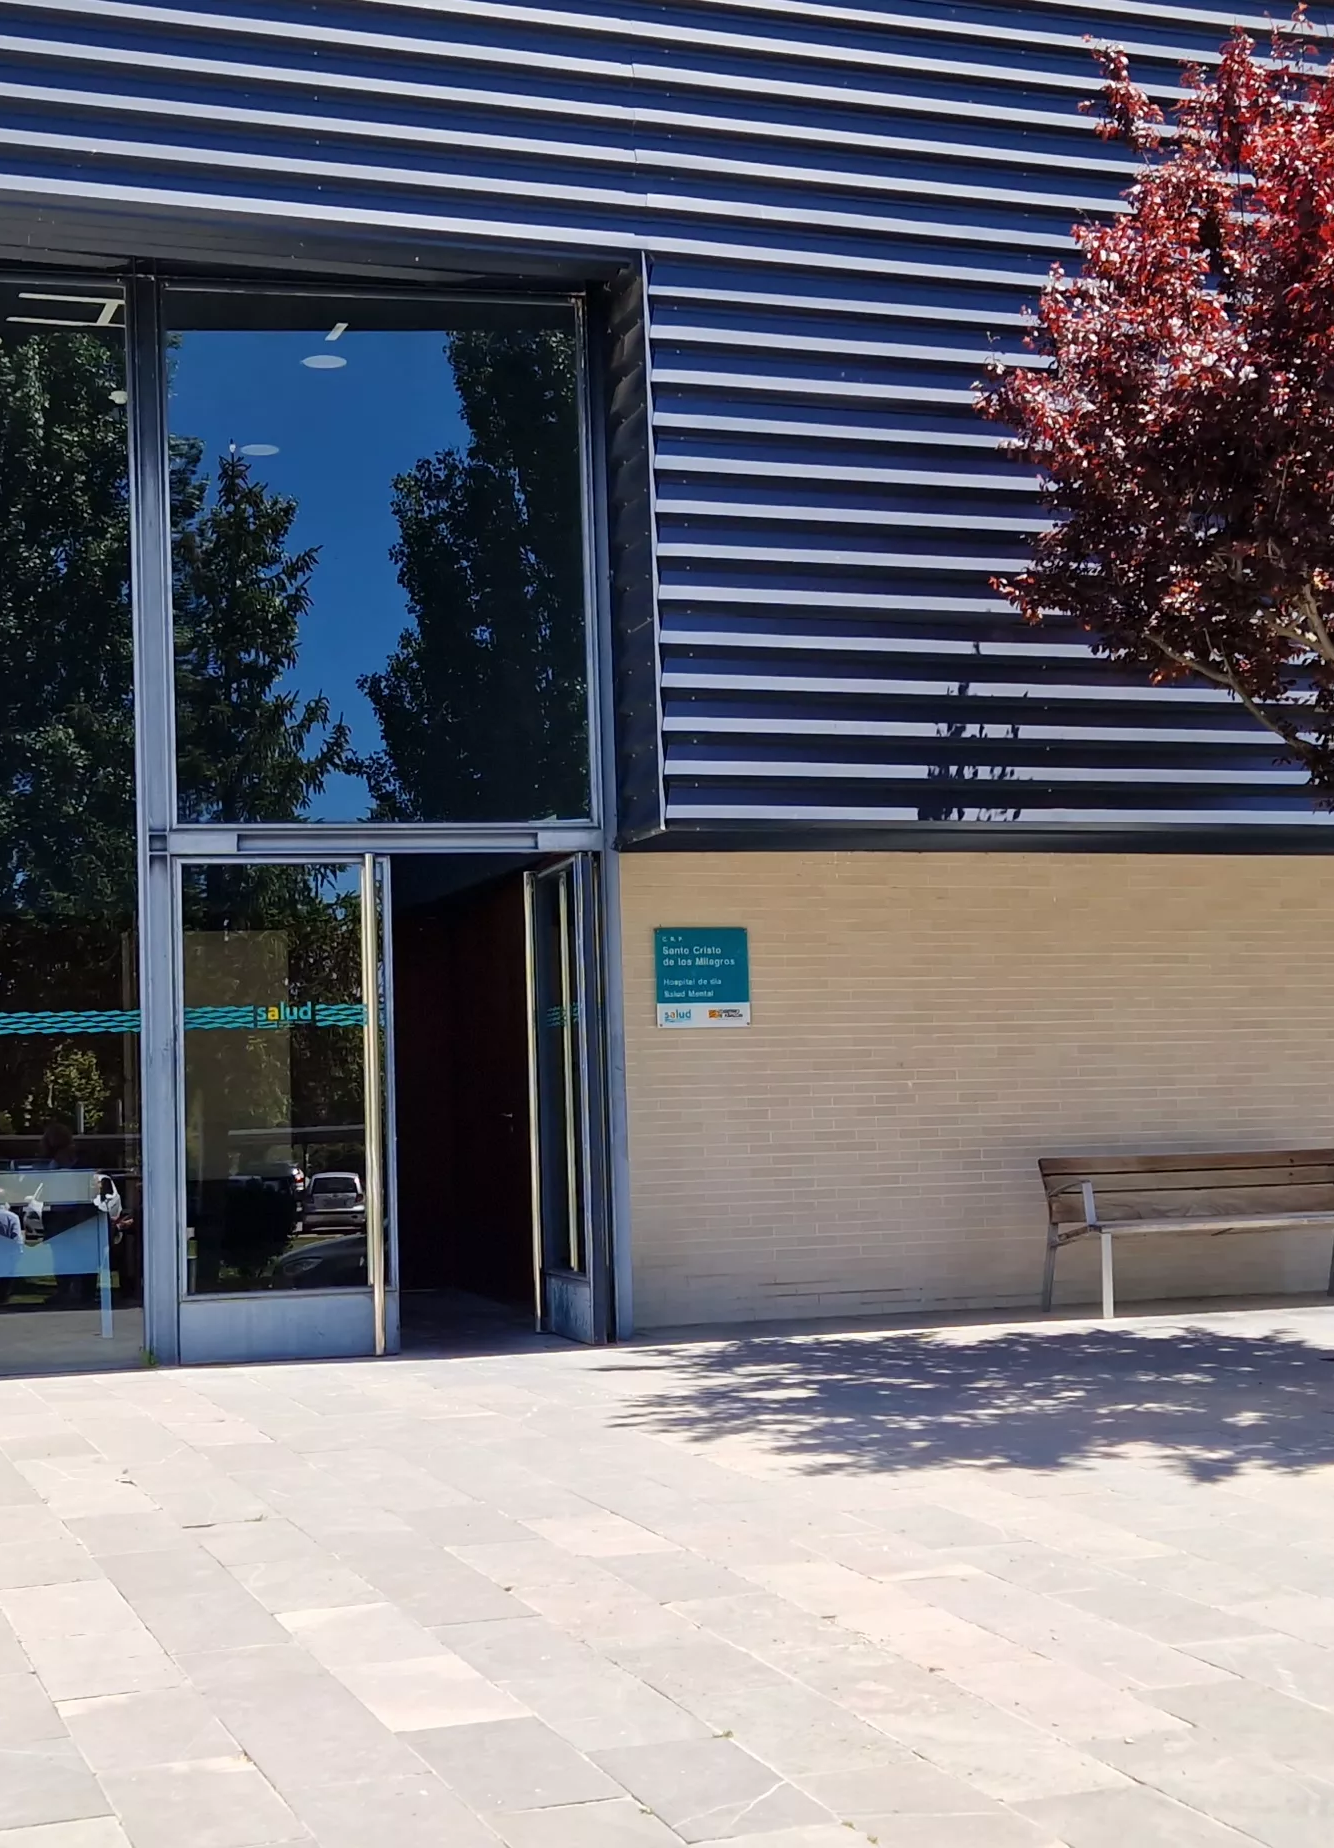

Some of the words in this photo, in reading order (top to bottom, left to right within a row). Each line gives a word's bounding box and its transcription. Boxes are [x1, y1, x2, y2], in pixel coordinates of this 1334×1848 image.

[663, 946, 689, 955] Santo
[693, 946, 722, 954] Cristo
[663, 958, 674, 966] de
[678, 958, 692, 966] los
[695, 957, 735, 967] Milagros
[663, 978, 695, 986] Hospital
[664, 990, 685, 998] Salud
[257, 1001, 312, 1020] salud
[664, 1009, 691, 1018] salud
